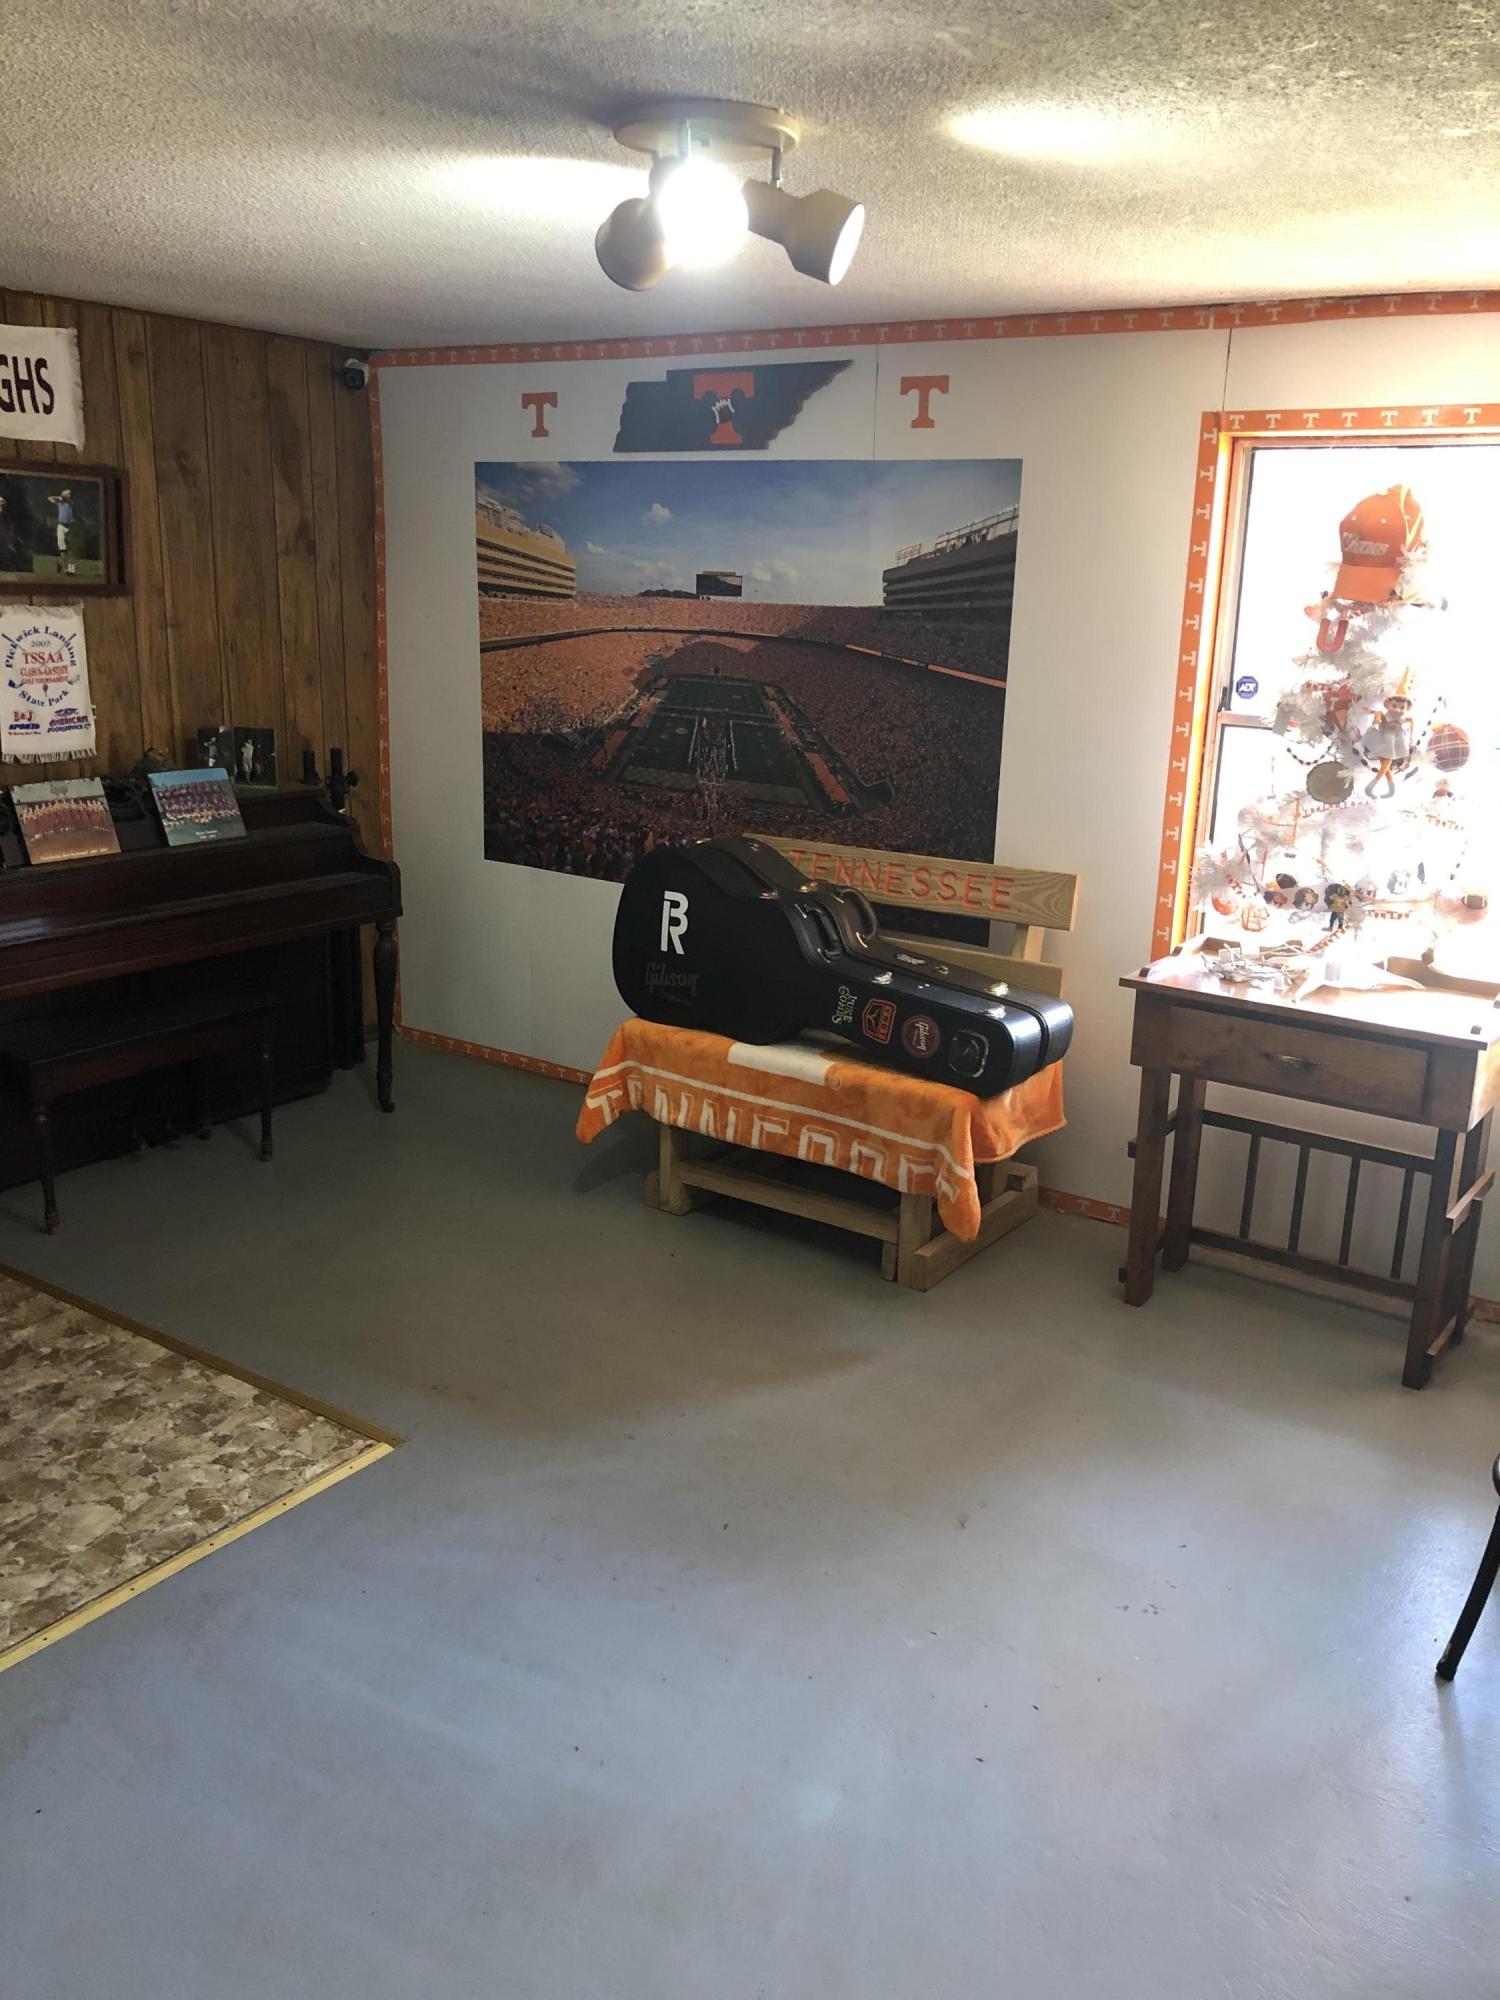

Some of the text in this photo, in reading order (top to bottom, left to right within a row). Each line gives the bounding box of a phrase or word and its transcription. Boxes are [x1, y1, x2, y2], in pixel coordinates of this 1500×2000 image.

[521, 391, 558, 438] T
[900, 375, 950, 429] T
[1230, 408, 1481, 428] T T T T T T T
[5, 626, 77, 669] Pickwick Landing
[22, 651, 64, 665] TSSAA
[18, 689, 70, 707] State Park
[1157, 429, 1217, 940] T T T T T T T T T T T T T T T
[1239, 682, 1257, 693] ADT
[789, 849, 1015, 912] TENNESSEE
[914, 1021, 930, 1051] Gibson
